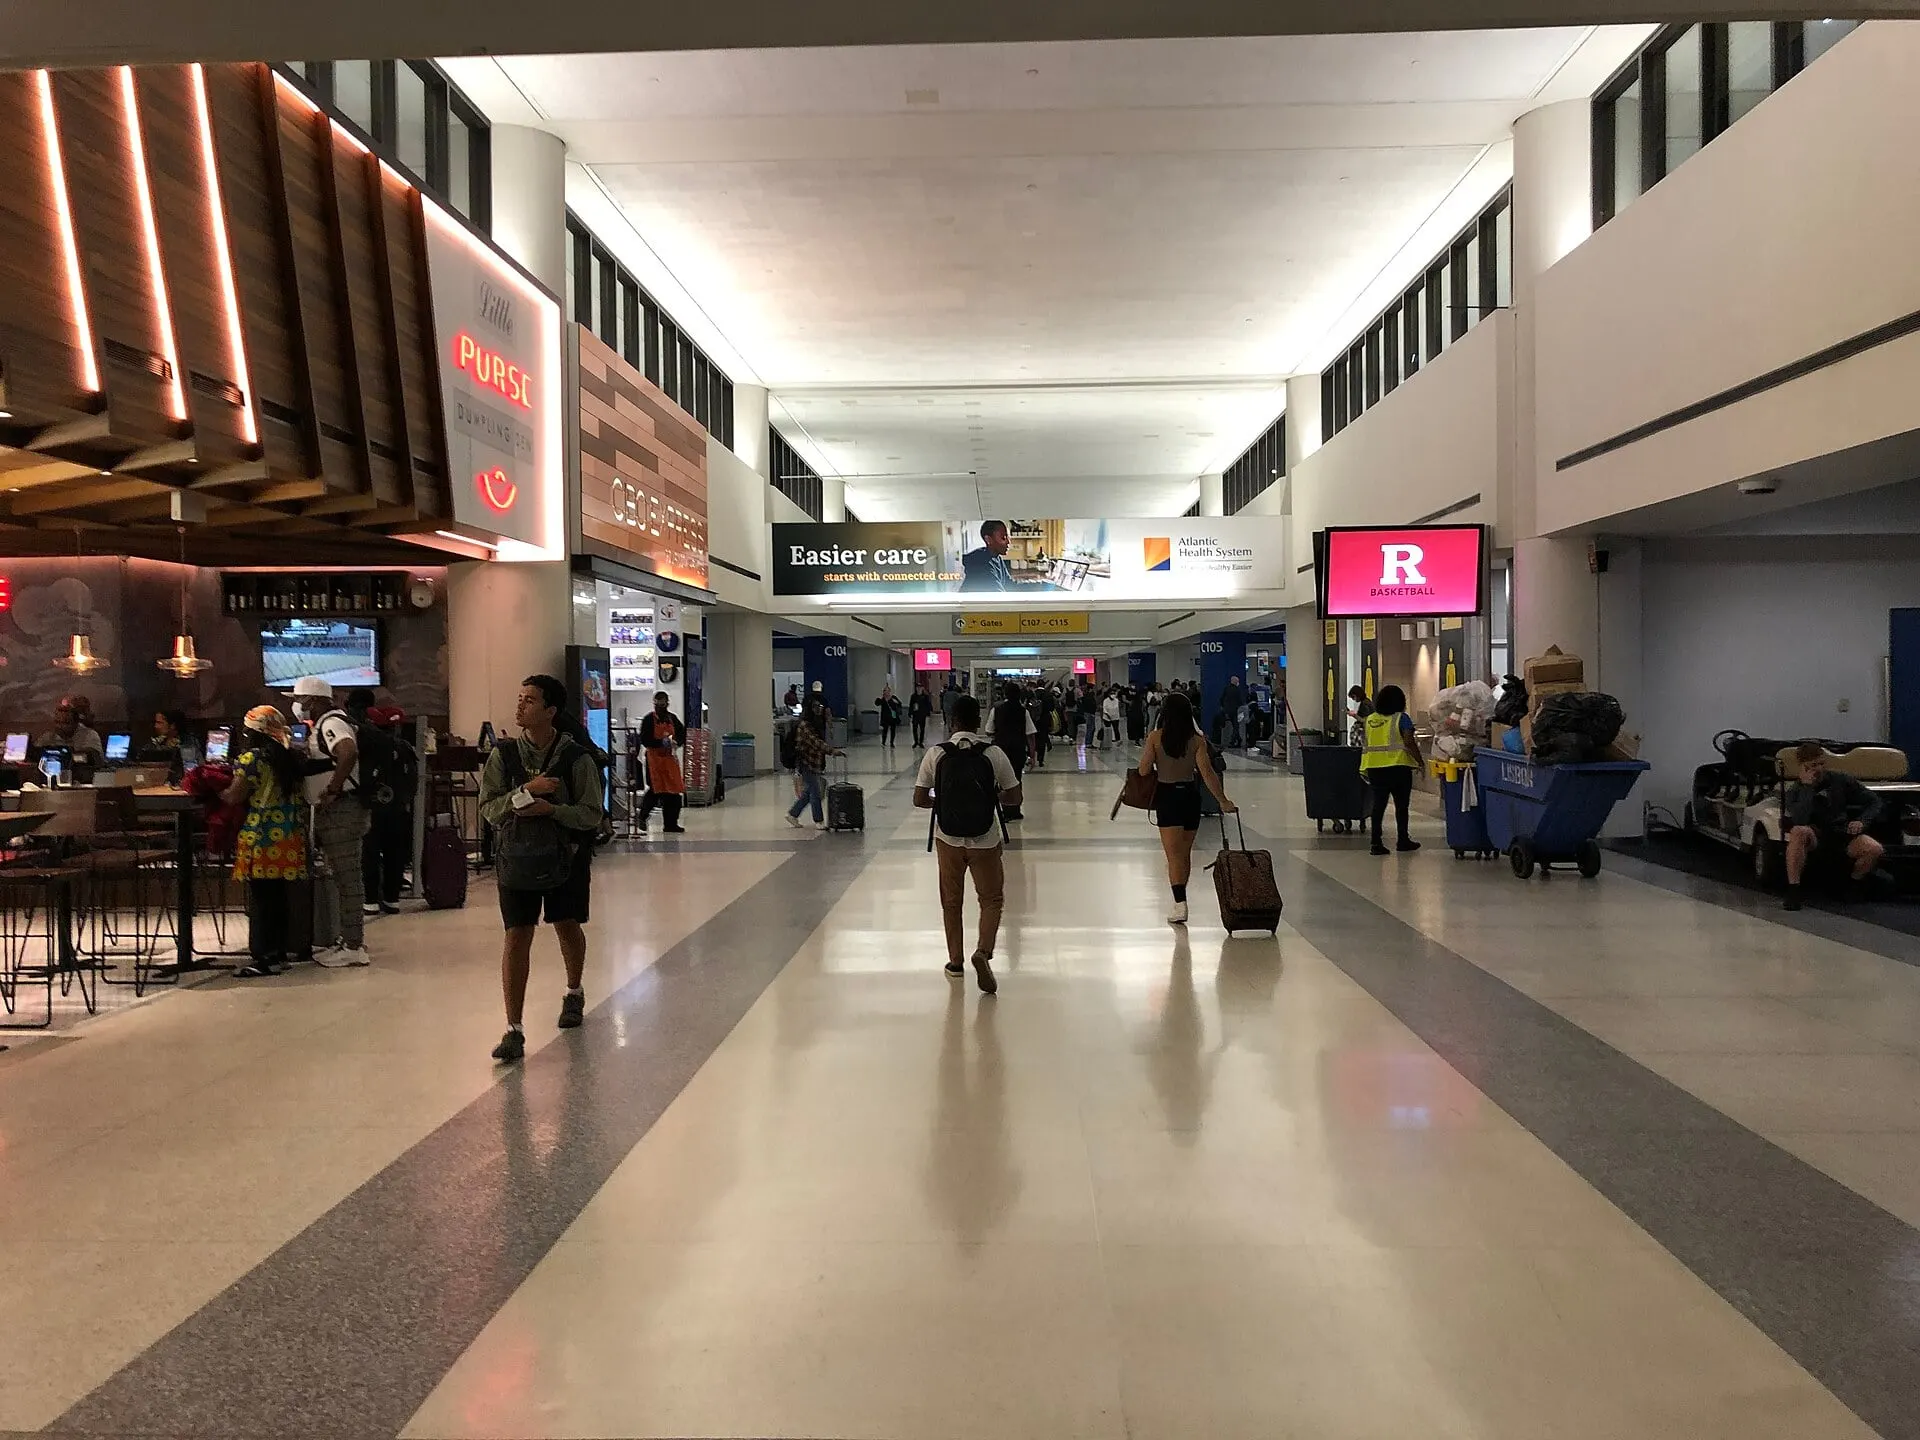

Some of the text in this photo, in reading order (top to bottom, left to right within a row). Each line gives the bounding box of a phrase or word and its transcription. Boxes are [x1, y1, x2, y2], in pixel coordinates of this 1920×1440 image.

[479, 280, 514, 337] Little
[460, 334, 533, 409] PURSE
[457, 402, 511, 443] DUMPLING
[1178, 536, 1218, 546] Atlantic
[789, 543, 928, 566] Easier care
[1178, 547, 1253, 559] Health System
[1379, 543, 1427, 585] R
[823, 572, 855, 582] starts
[856, 571, 880, 582] with
[882, 571, 937, 581] connected
[1369, 587, 1436, 597] BASKETBALL
[980, 619, 1003, 627] Gates
[1021, 618, 1041, 627] C107
[1048, 618, 1069, 627] C115
[824, 645, 847, 657] C104
[1200, 641, 1223, 653] C105
[926, 652, 939, 665] R
[1076, 660, 1086, 670] R
